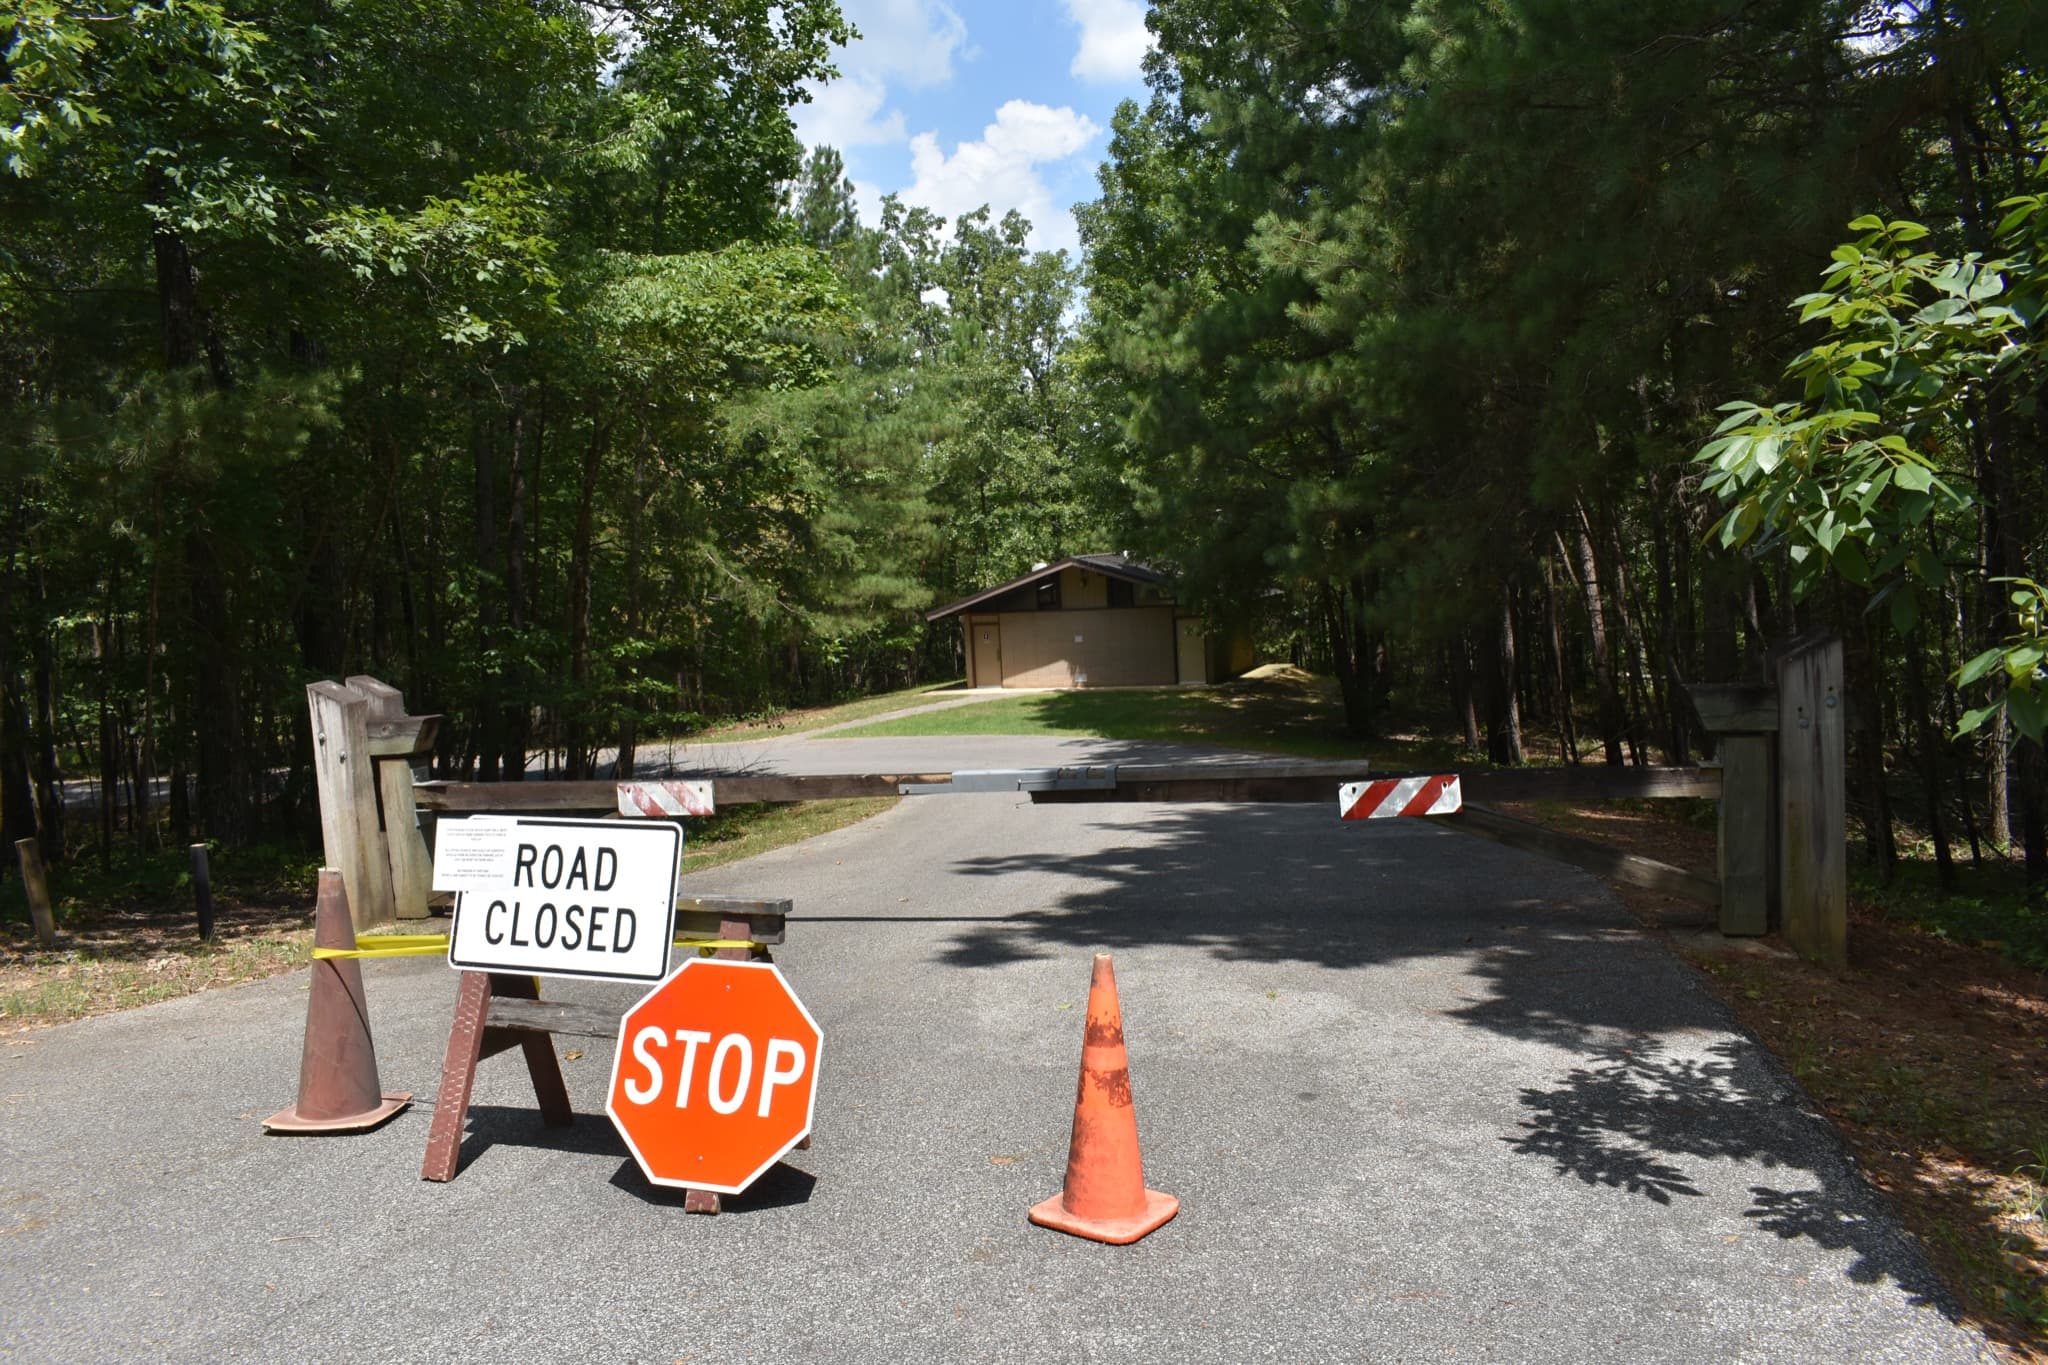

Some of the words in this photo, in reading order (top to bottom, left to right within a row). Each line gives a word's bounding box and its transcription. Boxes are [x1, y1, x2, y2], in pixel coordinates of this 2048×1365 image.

[514, 844, 618, 891] ROAD
[485, 900, 637, 953] CLOSED
[624, 1026, 806, 1118] STOP
